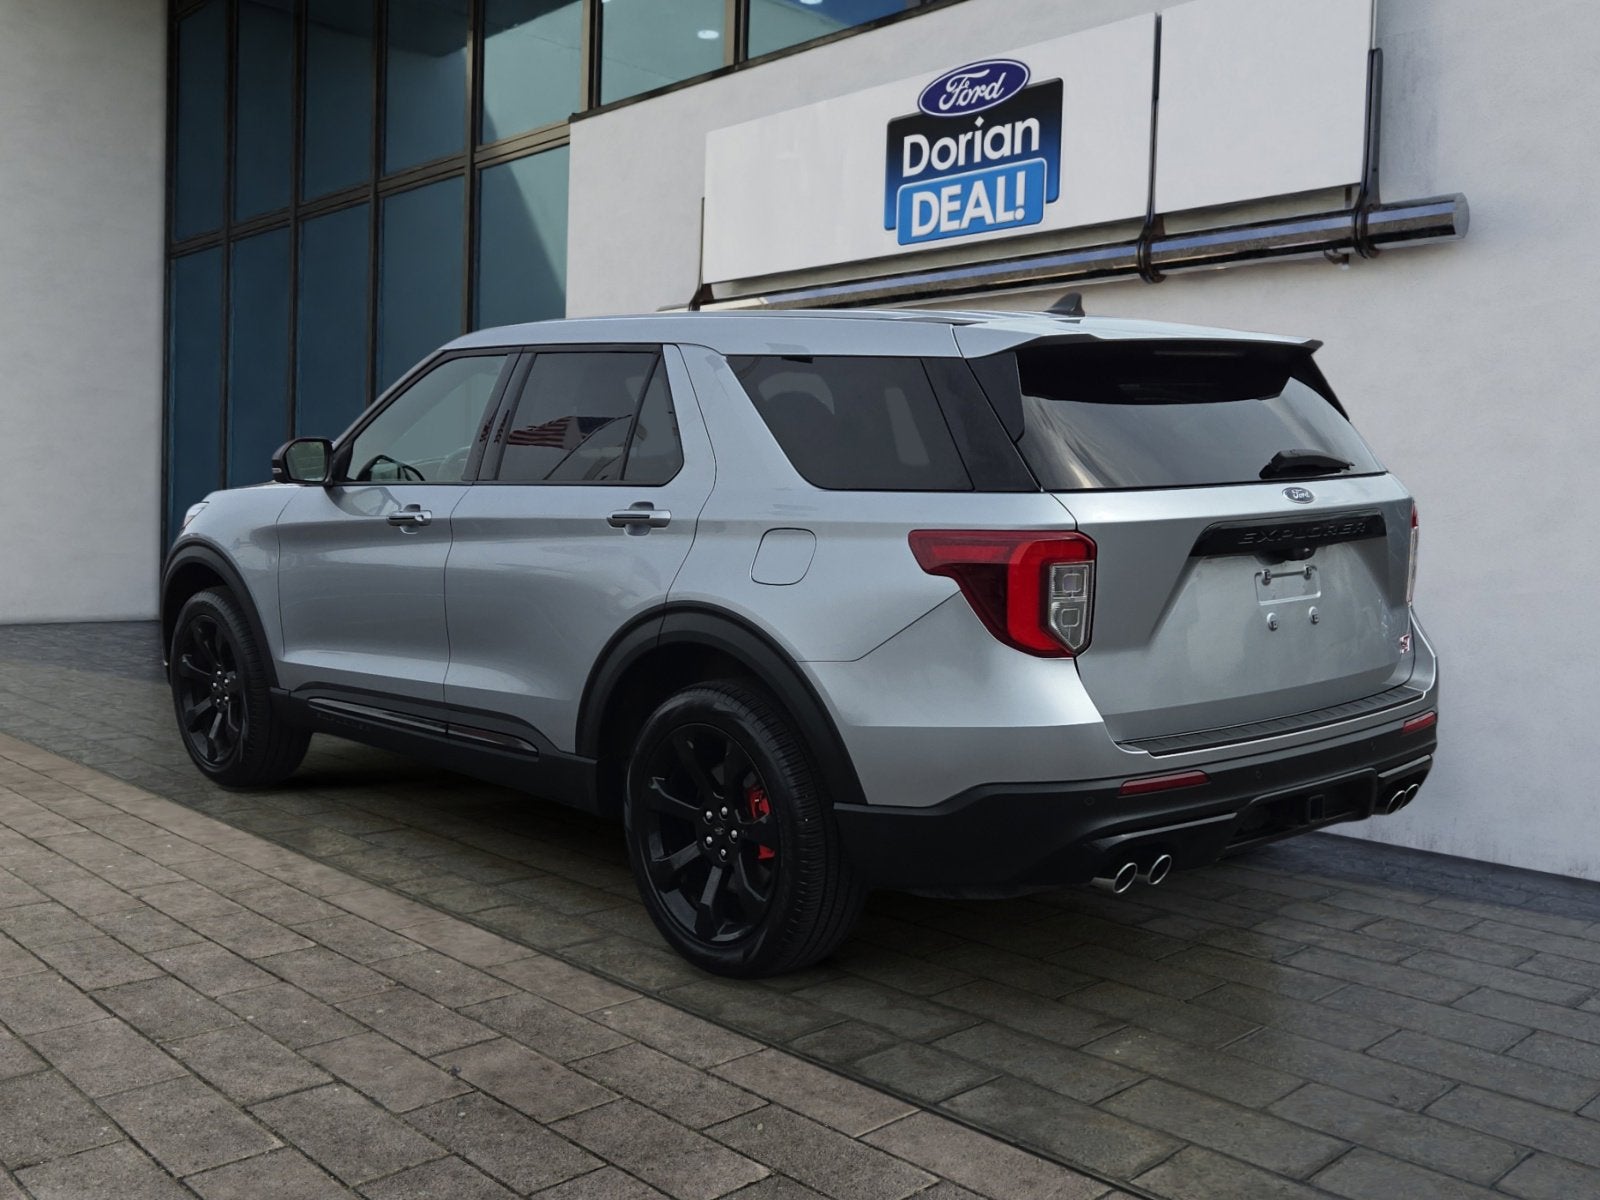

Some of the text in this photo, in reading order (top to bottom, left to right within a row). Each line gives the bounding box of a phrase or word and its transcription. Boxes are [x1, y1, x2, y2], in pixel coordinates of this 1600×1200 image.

[938, 69, 1007, 111] Ford
[902, 115, 1040, 178] Dorian
[911, 170, 1026, 237] DEAL!
[1237, 522, 1366, 545] EXPLORER
